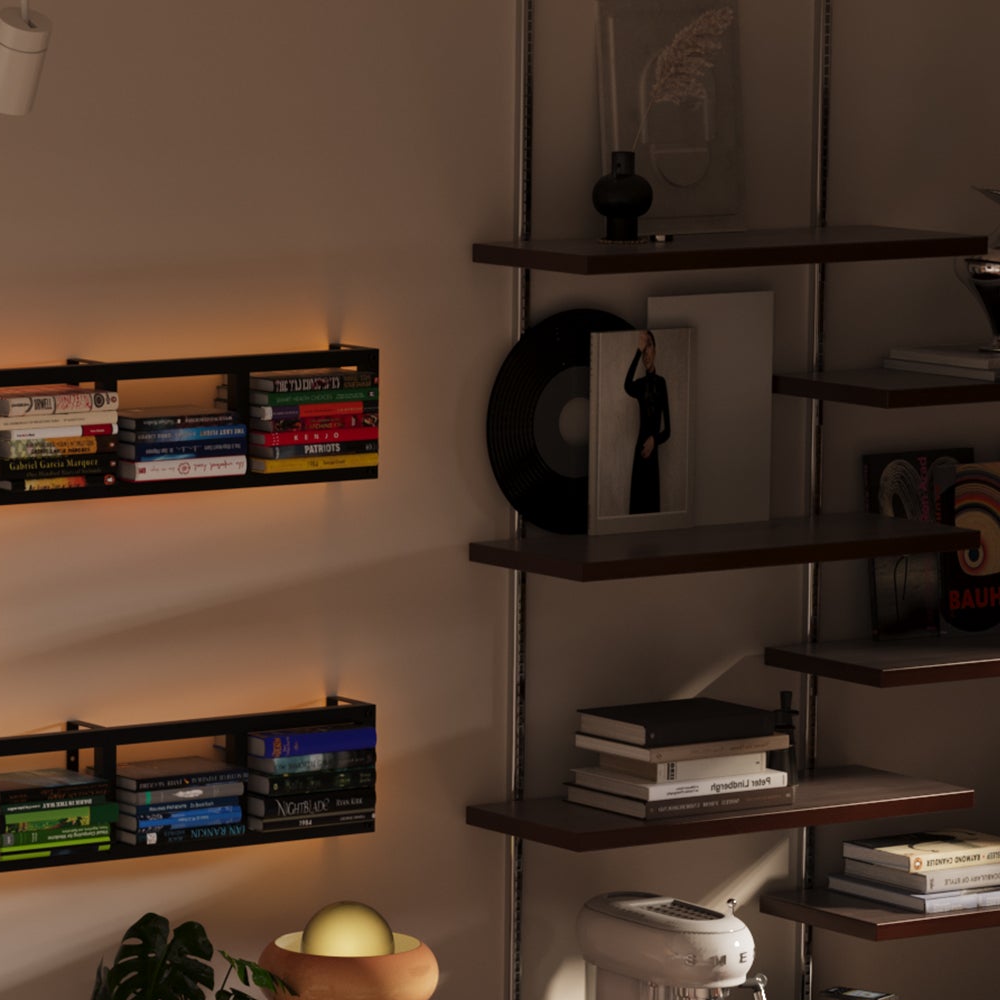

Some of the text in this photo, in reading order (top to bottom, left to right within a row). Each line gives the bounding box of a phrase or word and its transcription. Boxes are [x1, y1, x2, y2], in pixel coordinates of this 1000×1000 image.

[304, 443, 341, 454] PATRIOTS
[9, 461, 38, 471] Gabriel
[191, 826, 226, 839] RANKIN
[228, 824, 246, 835] IAN
[926, 857, 953, 867] CHANDLER
[954, 854, 980, 864] RAYMOND
